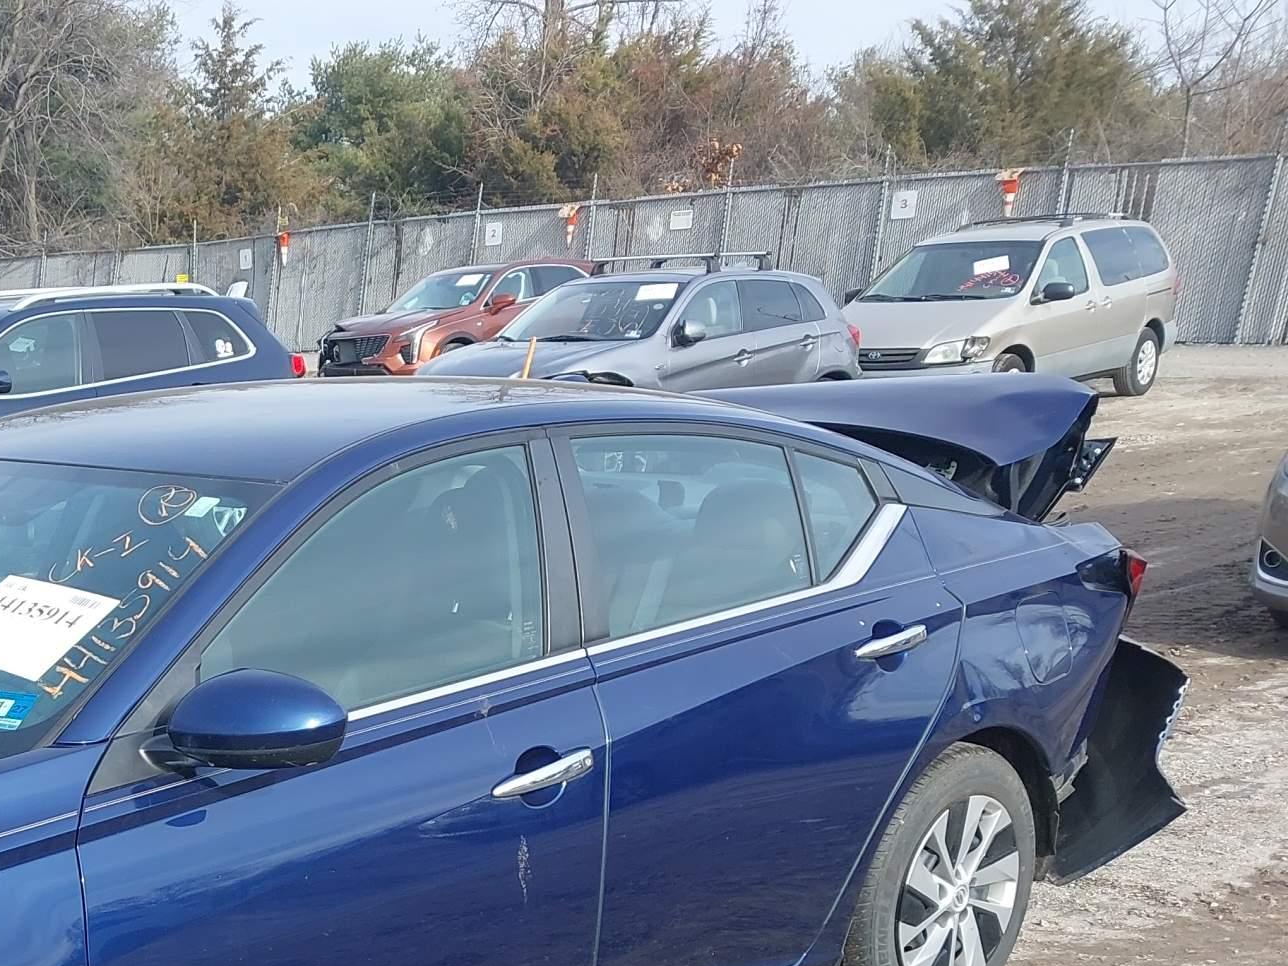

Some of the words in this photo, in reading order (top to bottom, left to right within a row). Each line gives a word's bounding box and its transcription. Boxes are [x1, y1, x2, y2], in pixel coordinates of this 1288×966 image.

[899, 199, 909, 209] 3
[490, 229, 498, 239] 2
[37, 536, 209, 699] 44135914
